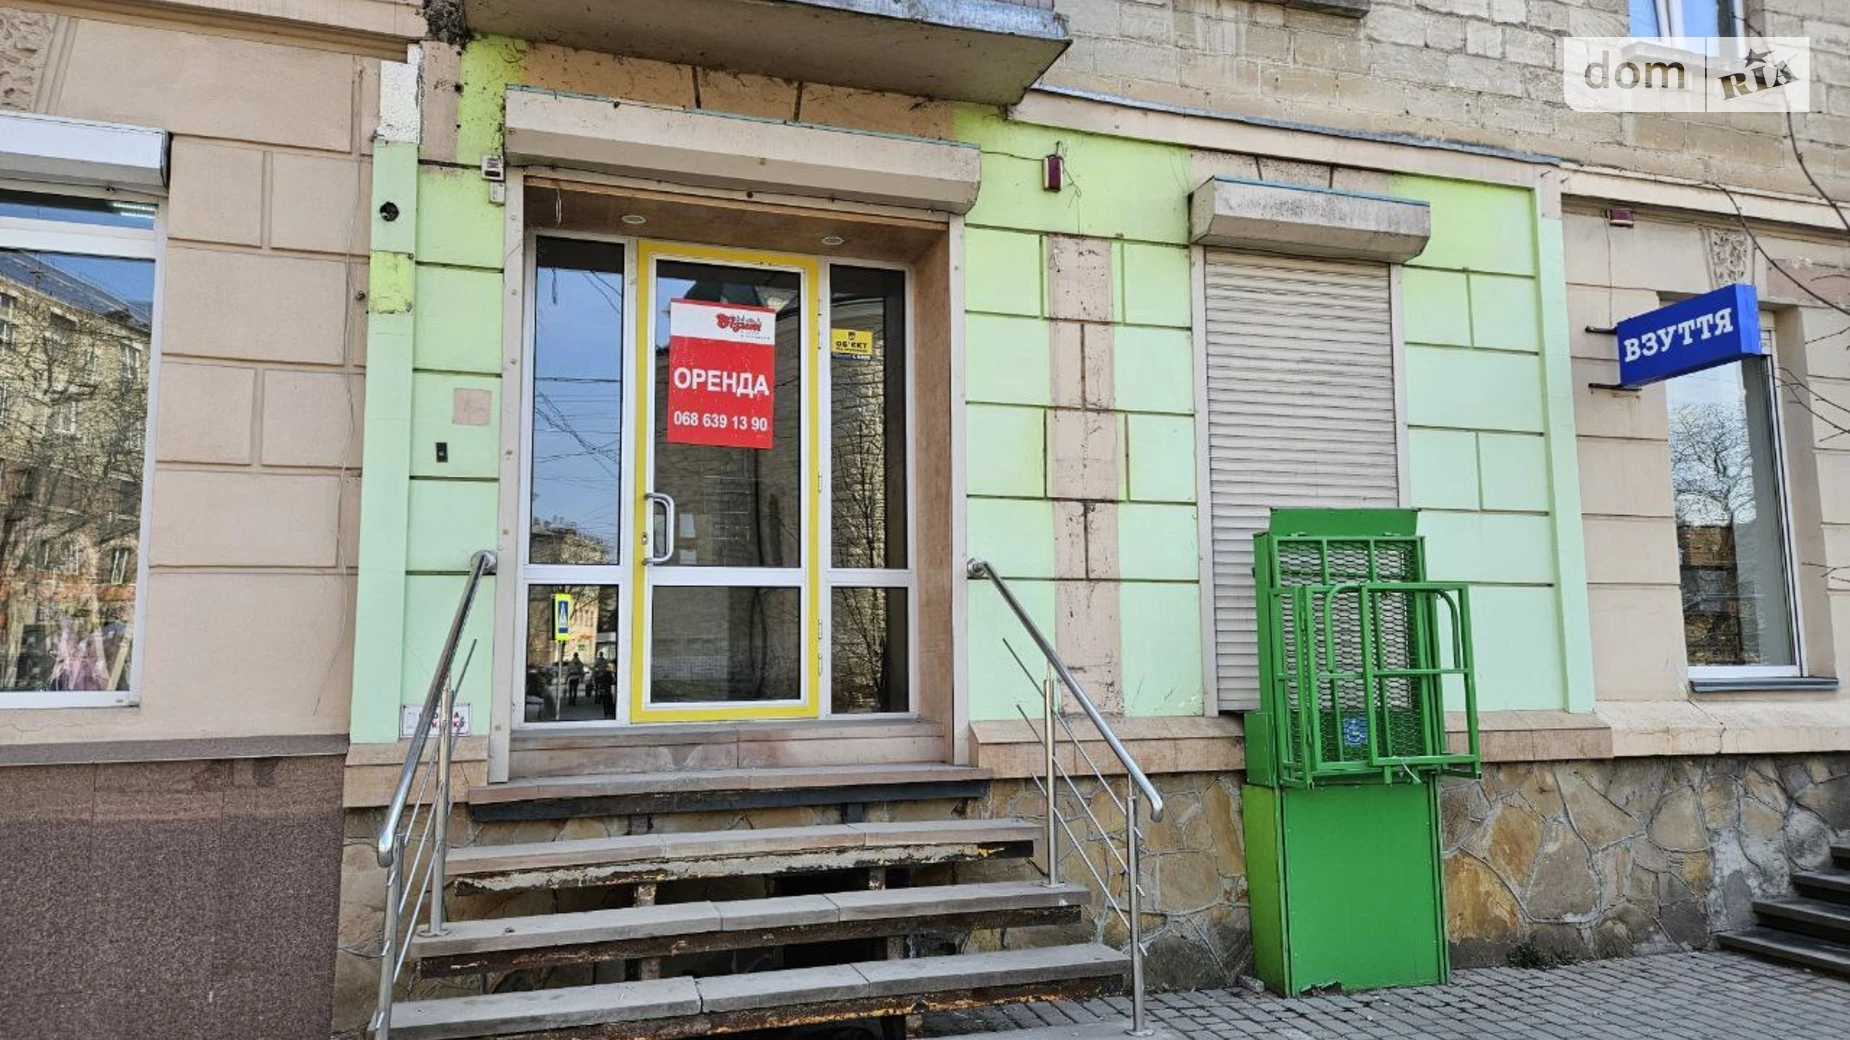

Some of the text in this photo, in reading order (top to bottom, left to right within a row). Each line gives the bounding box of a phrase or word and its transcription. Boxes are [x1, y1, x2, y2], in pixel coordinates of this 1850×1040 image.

[1623, 307, 1734, 362] ВЗУТТЯ
[673, 366, 770, 398] ОРЕНДА
[673, 410, 768, 431] 068 639 13 90
